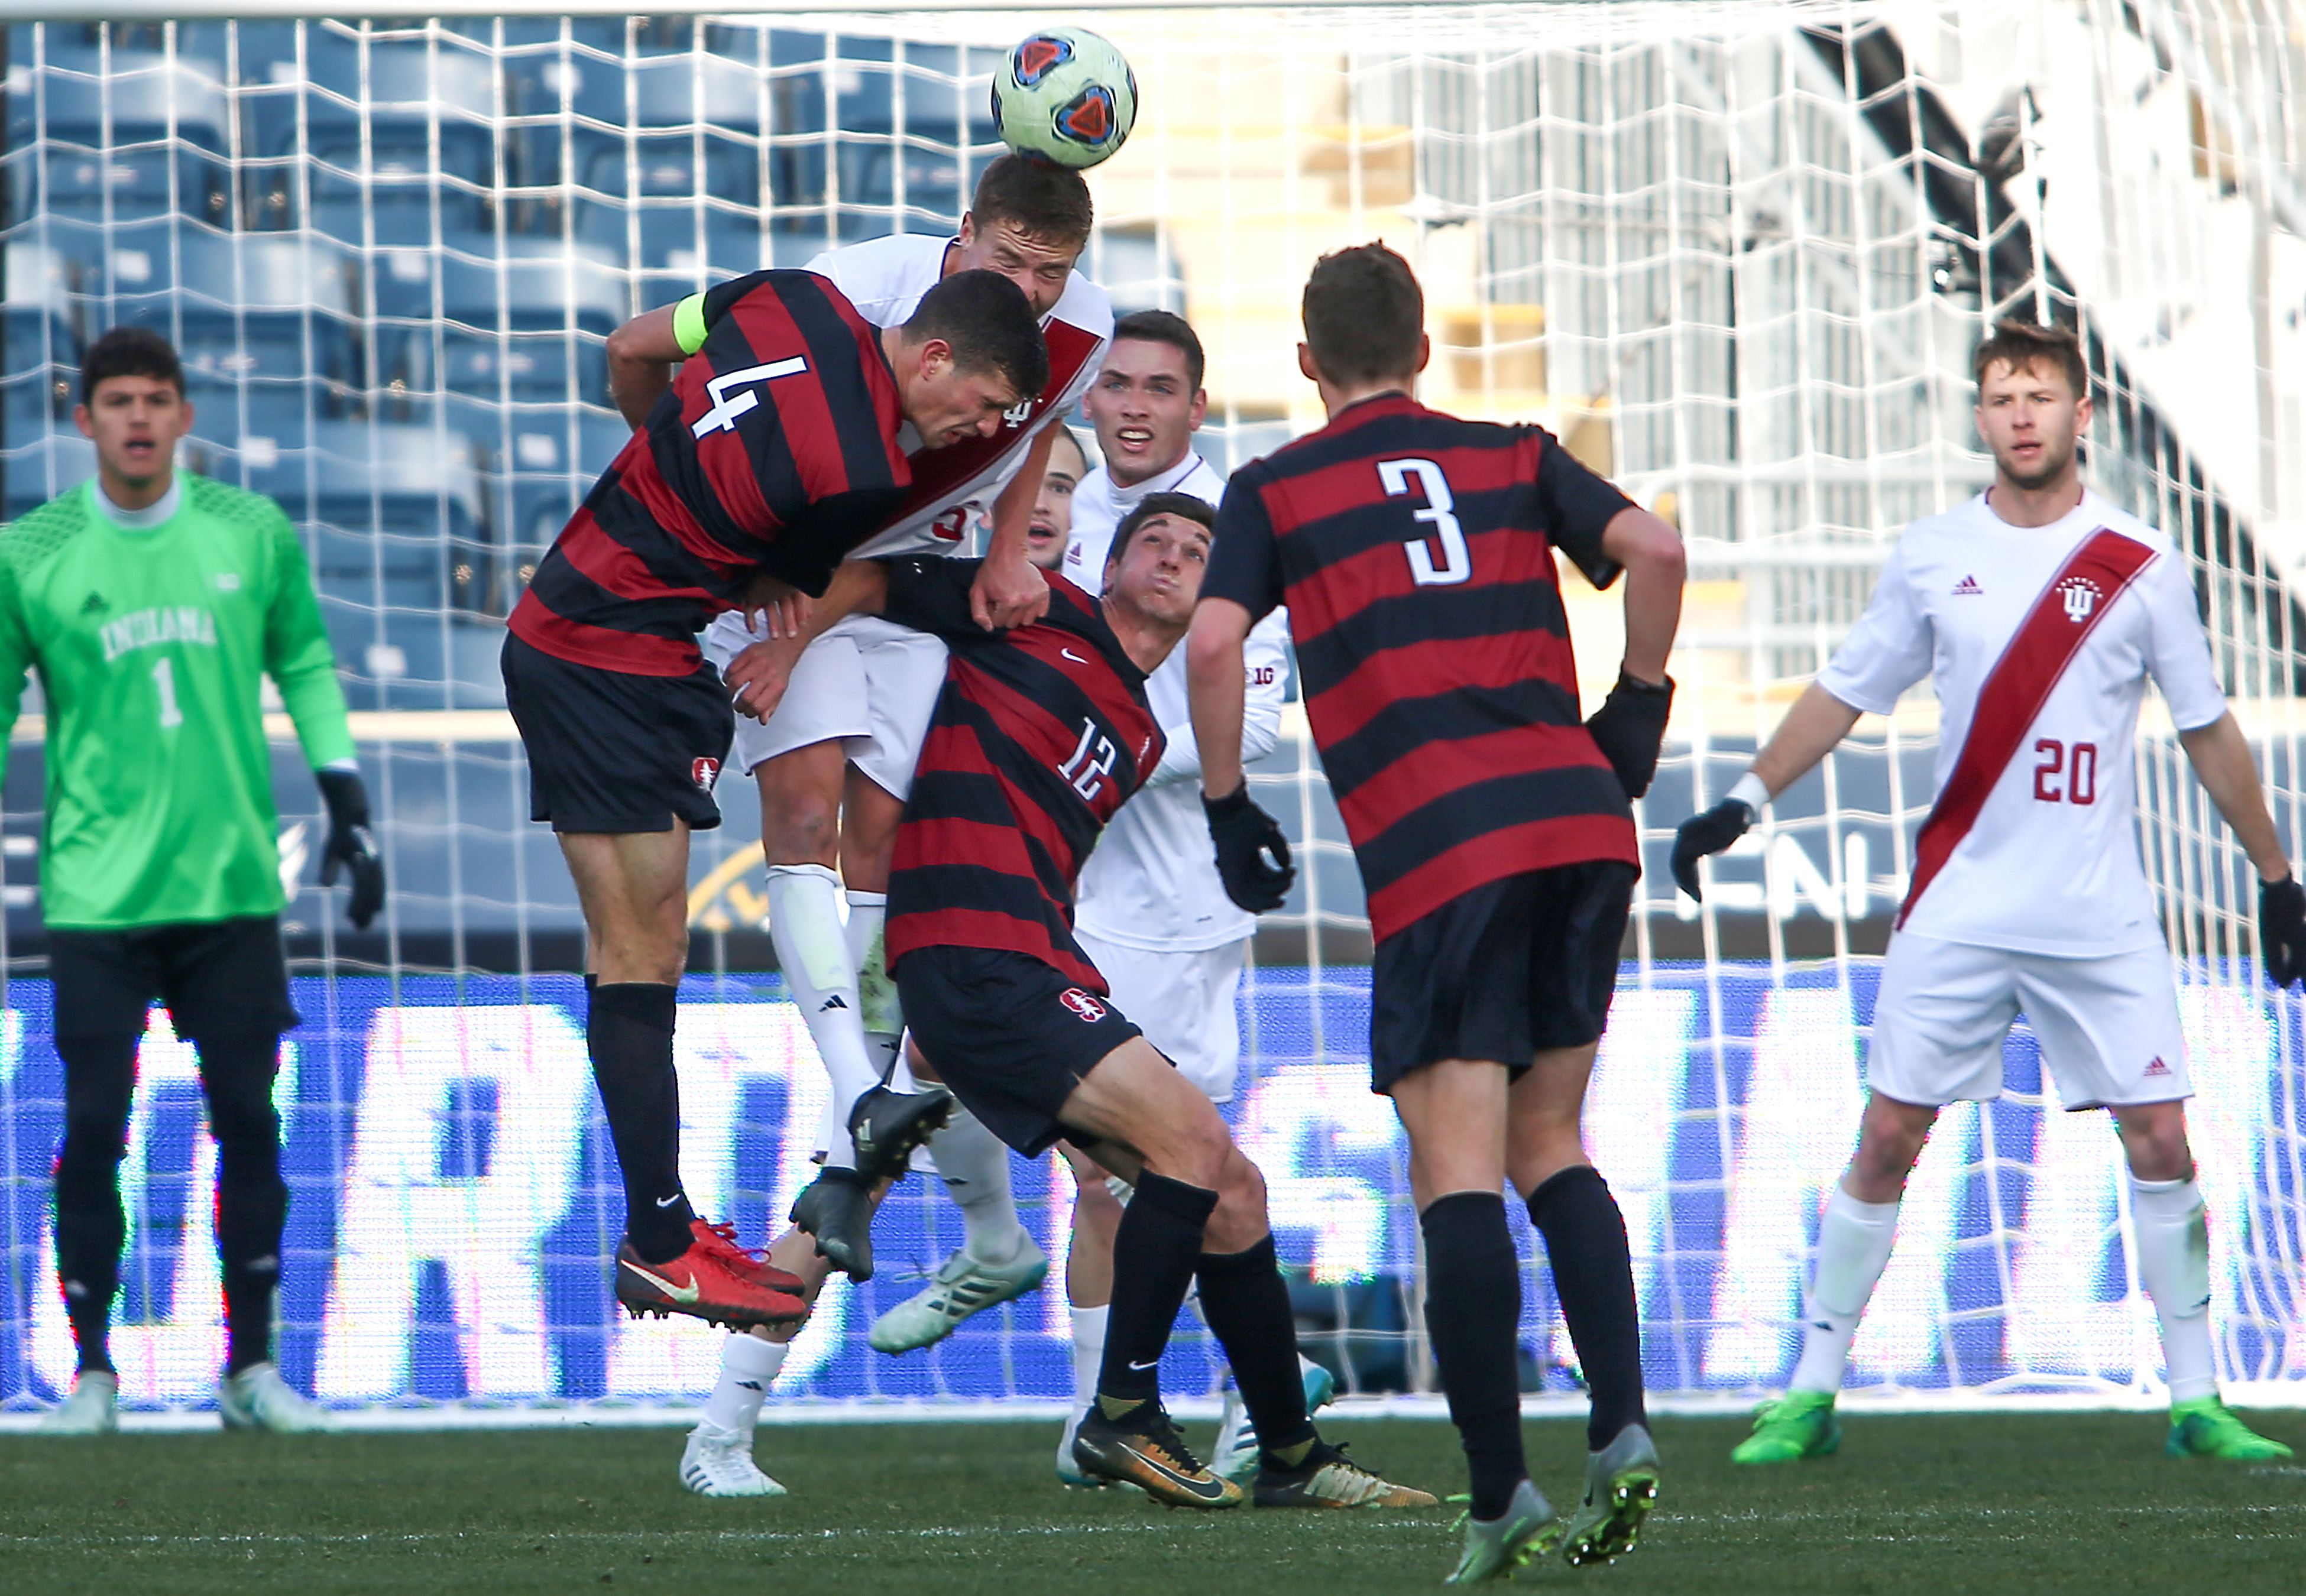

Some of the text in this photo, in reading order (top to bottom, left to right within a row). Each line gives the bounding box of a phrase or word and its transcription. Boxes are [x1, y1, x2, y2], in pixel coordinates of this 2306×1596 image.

[691, 355, 808, 439] 4
[1376, 457, 1472, 587] 3
[99, 606, 217, 661] INDIANA
[152, 657, 183, 728] 1
[1057, 715, 1117, 800] 12
[2033, 738, 2097, 805] 20
